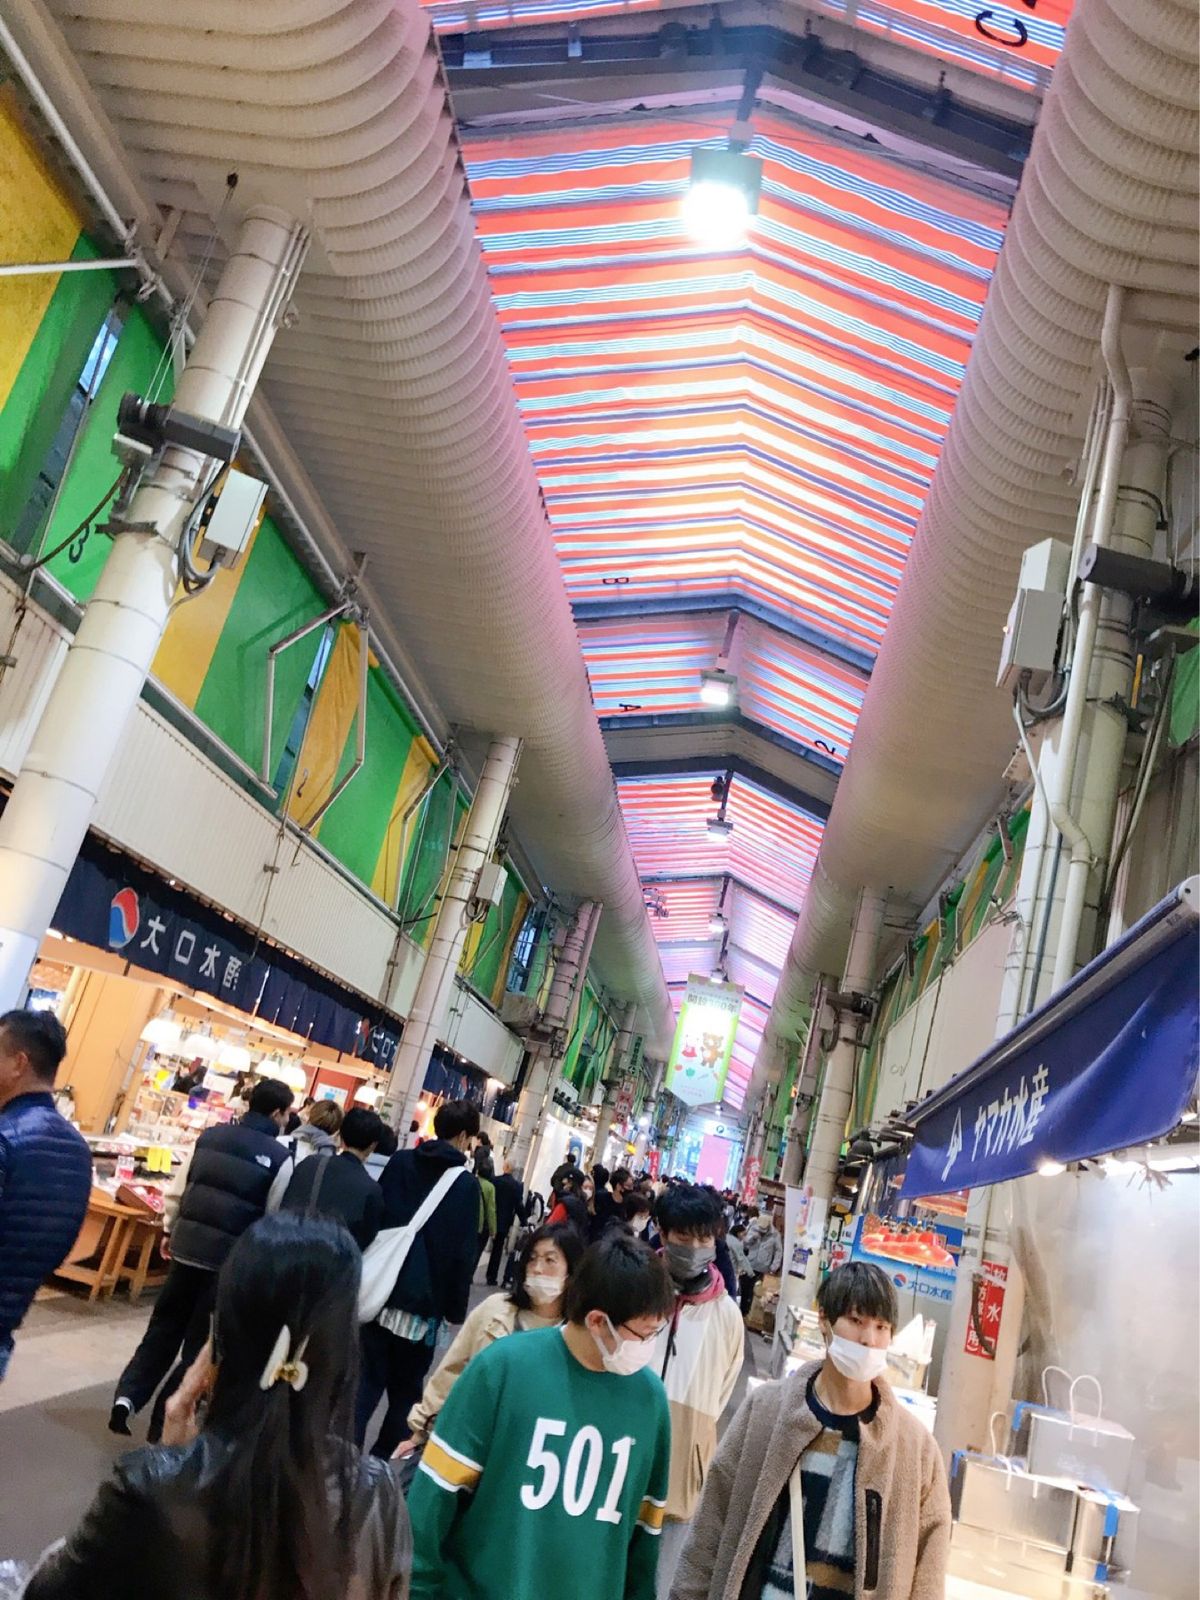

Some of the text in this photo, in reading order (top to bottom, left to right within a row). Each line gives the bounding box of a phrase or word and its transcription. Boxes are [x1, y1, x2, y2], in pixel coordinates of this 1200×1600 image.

[971, 1063, 1049, 1162] ヤマカ水産
[520, 1417, 631, 1525] 501
